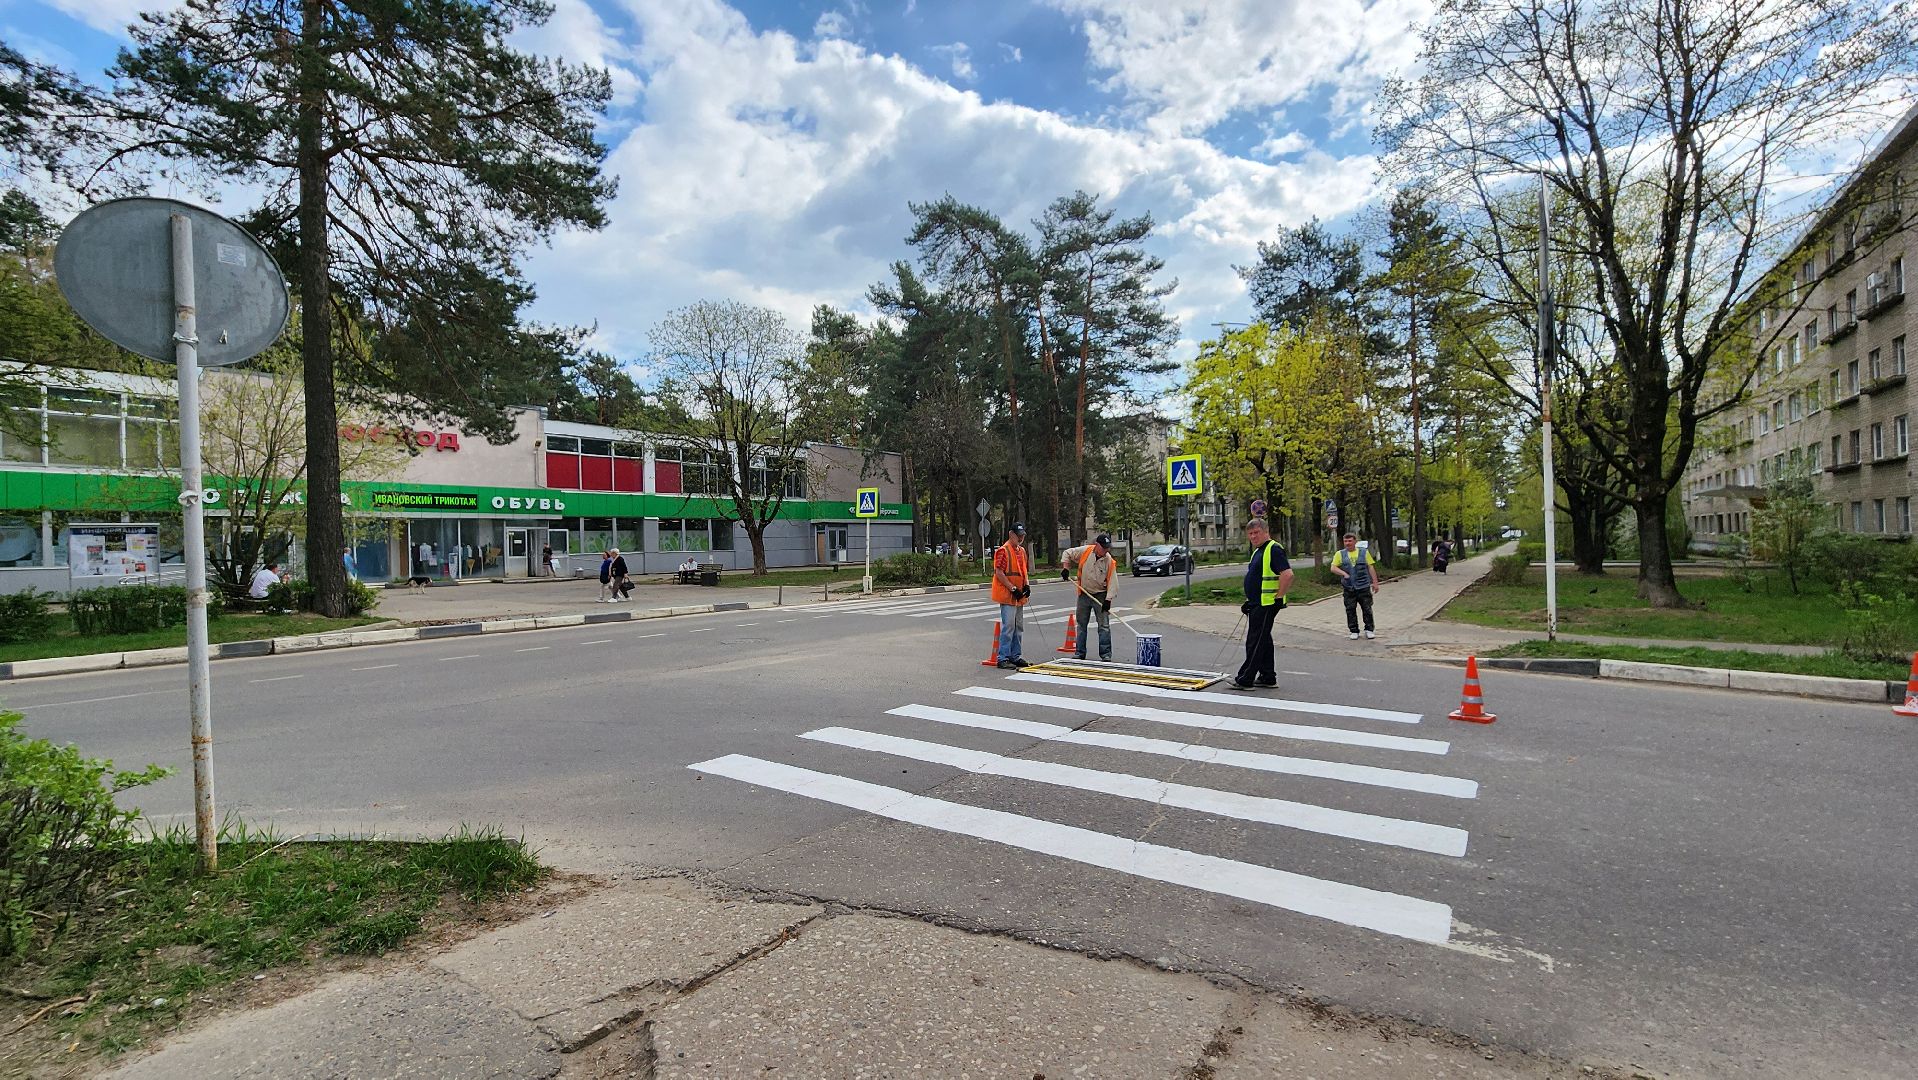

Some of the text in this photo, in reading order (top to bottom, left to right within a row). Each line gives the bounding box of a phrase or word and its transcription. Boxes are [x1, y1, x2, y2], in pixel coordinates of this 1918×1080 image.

[202, 488, 352, 505] ОДЕЖА
[375, 494, 477, 506] ИВАНОВСКИЙ ТРИКОТАЖ
[491, 496, 566, 511] ОБУВЬ
